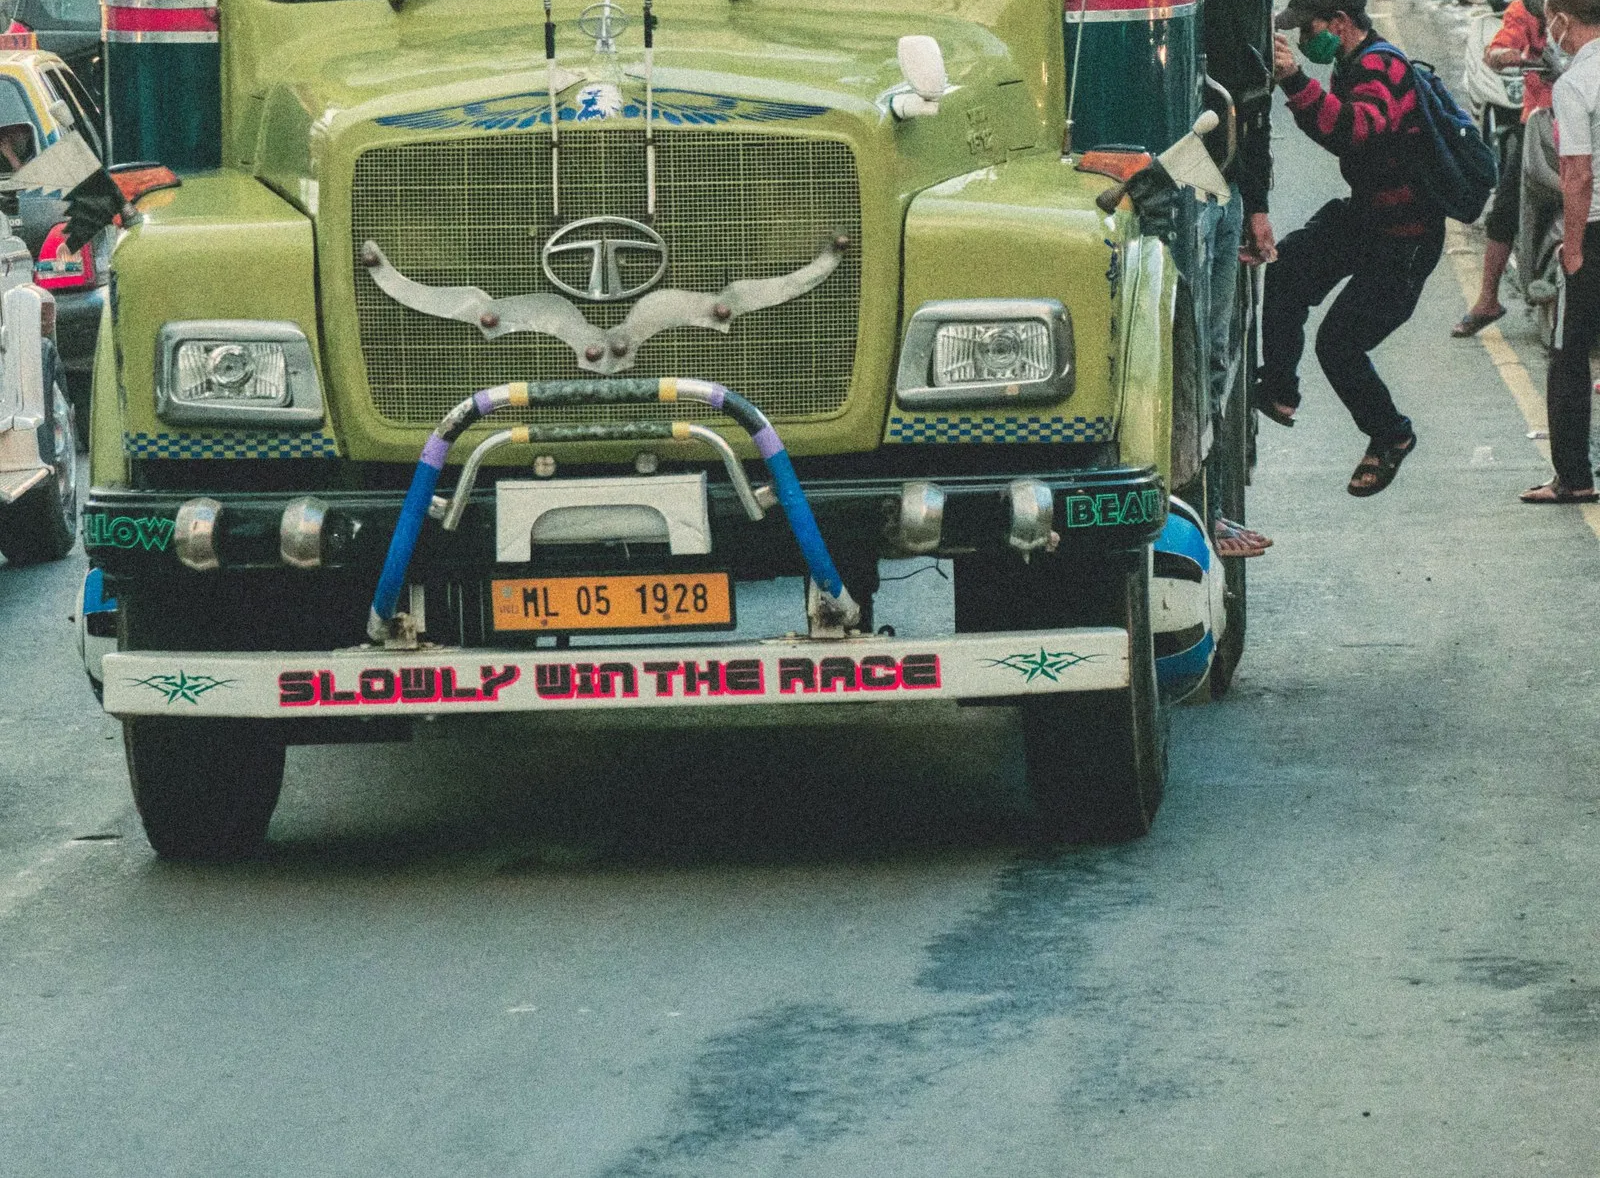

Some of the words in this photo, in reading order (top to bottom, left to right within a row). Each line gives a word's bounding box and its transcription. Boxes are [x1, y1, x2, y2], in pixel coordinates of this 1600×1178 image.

[522, 586, 559, 618] ML
[576, 584, 611, 616] 05
[635, 581, 708, 615] 1928
[279, 665, 521, 707] SLOWLY
[778, 653, 942, 695] RACE
